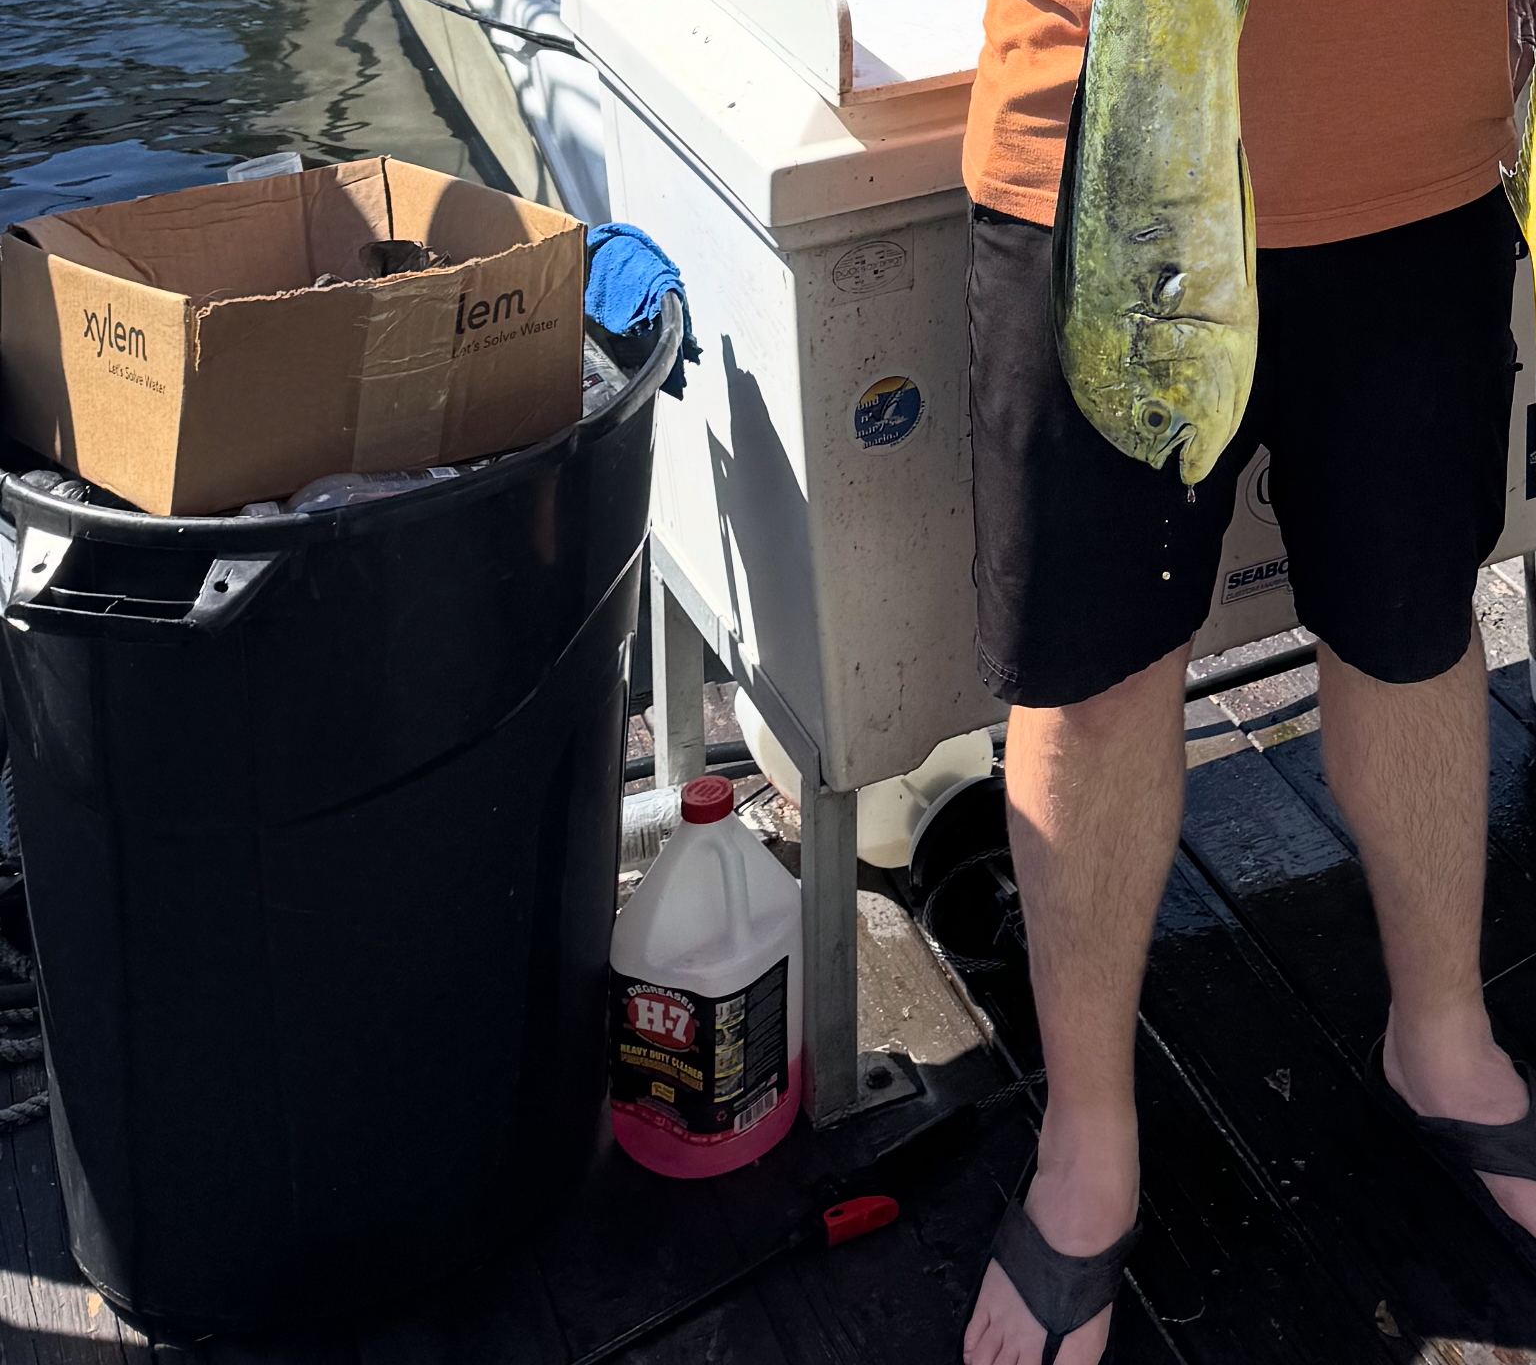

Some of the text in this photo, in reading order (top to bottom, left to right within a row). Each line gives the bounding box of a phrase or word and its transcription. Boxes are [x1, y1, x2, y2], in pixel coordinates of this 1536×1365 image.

[83, 302, 148, 362] xylem
[451, 317, 560, 360] Let's Solve Water
[108, 359, 166, 395] Let's Solve Water
[626, 983, 696, 1015] DEGREASER
[634, 996, 690, 1044] H-7
[620, 1043, 648, 1057] HEAVY
[649, 1049, 670, 1064] DUTY
